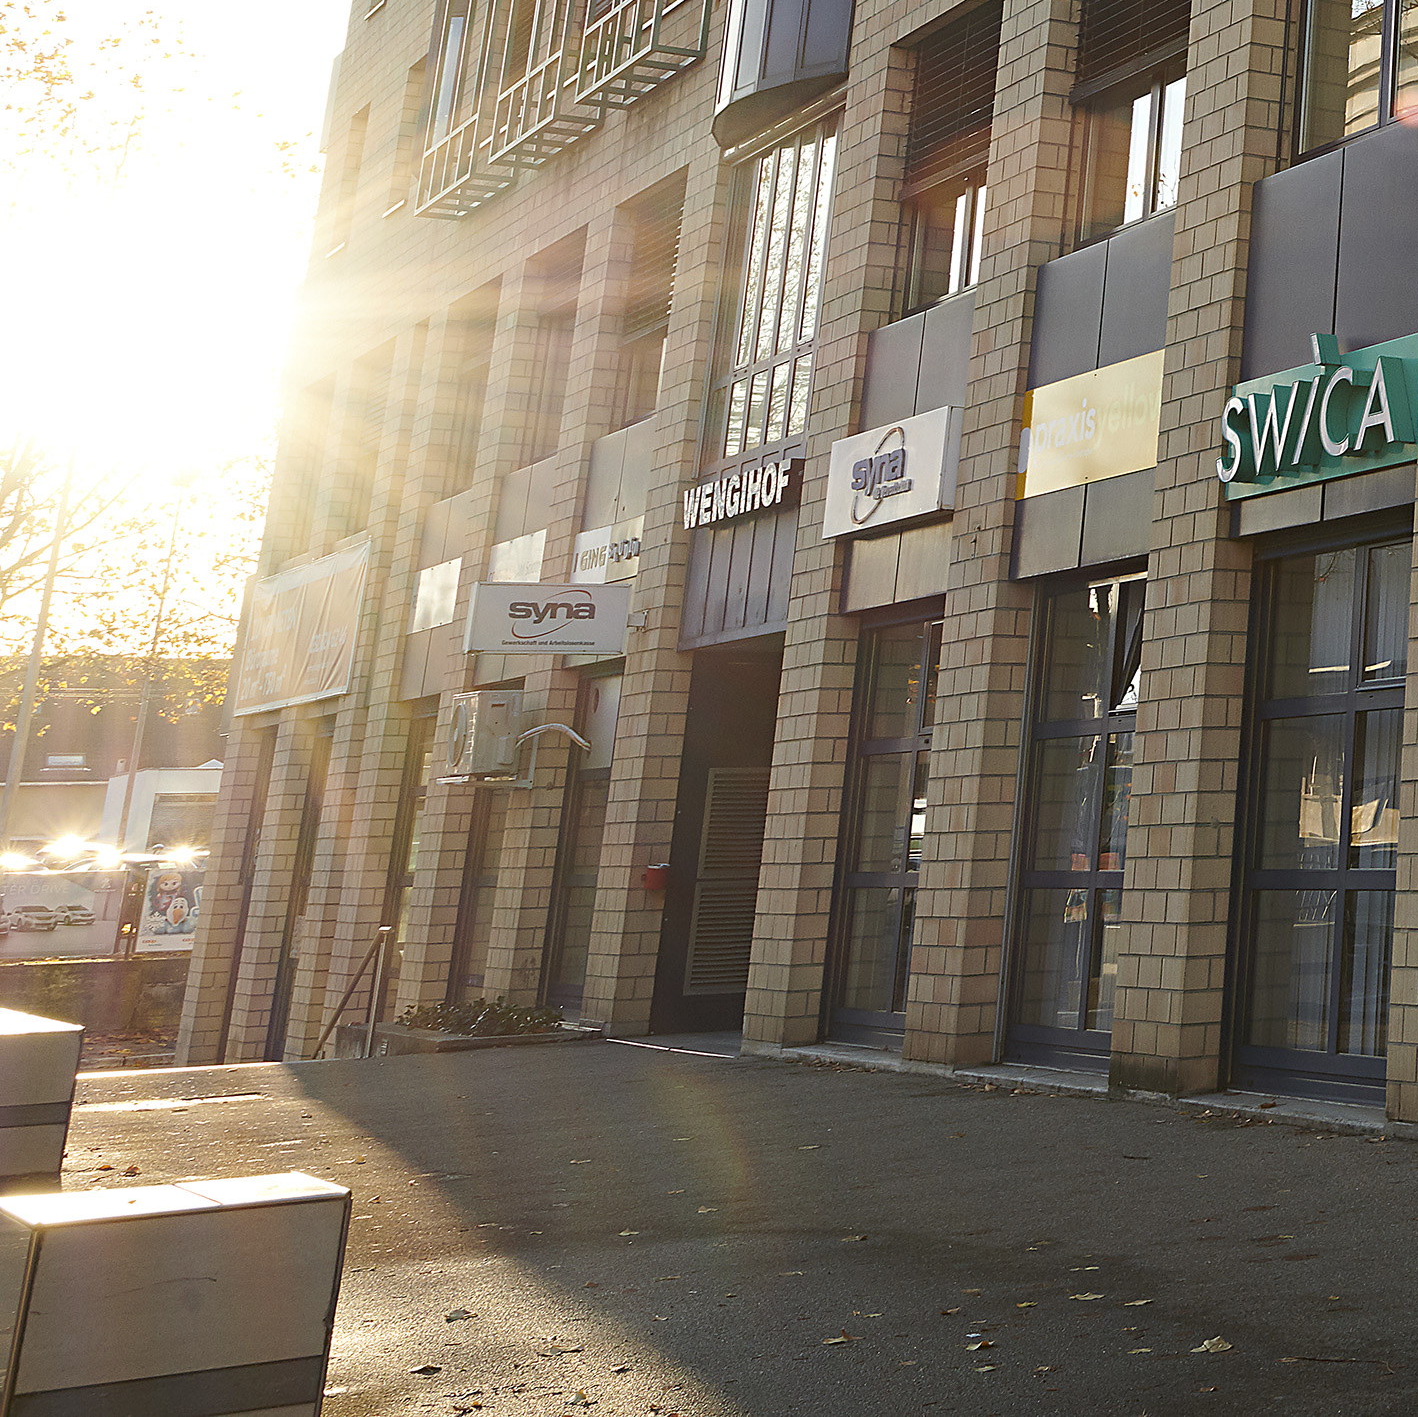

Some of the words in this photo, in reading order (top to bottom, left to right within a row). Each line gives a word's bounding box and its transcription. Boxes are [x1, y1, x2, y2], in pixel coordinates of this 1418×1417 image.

[850, 447, 907, 497] syna
[683, 457, 792, 531] WENGIHOF
[580, 545, 608, 572] GING
[507, 601, 597, 625] syna
[501, 639, 538, 647] Gewerkschaft
[538, 639, 548, 647] und
[549, 639, 596, 647] Arbeitslosenkasse
